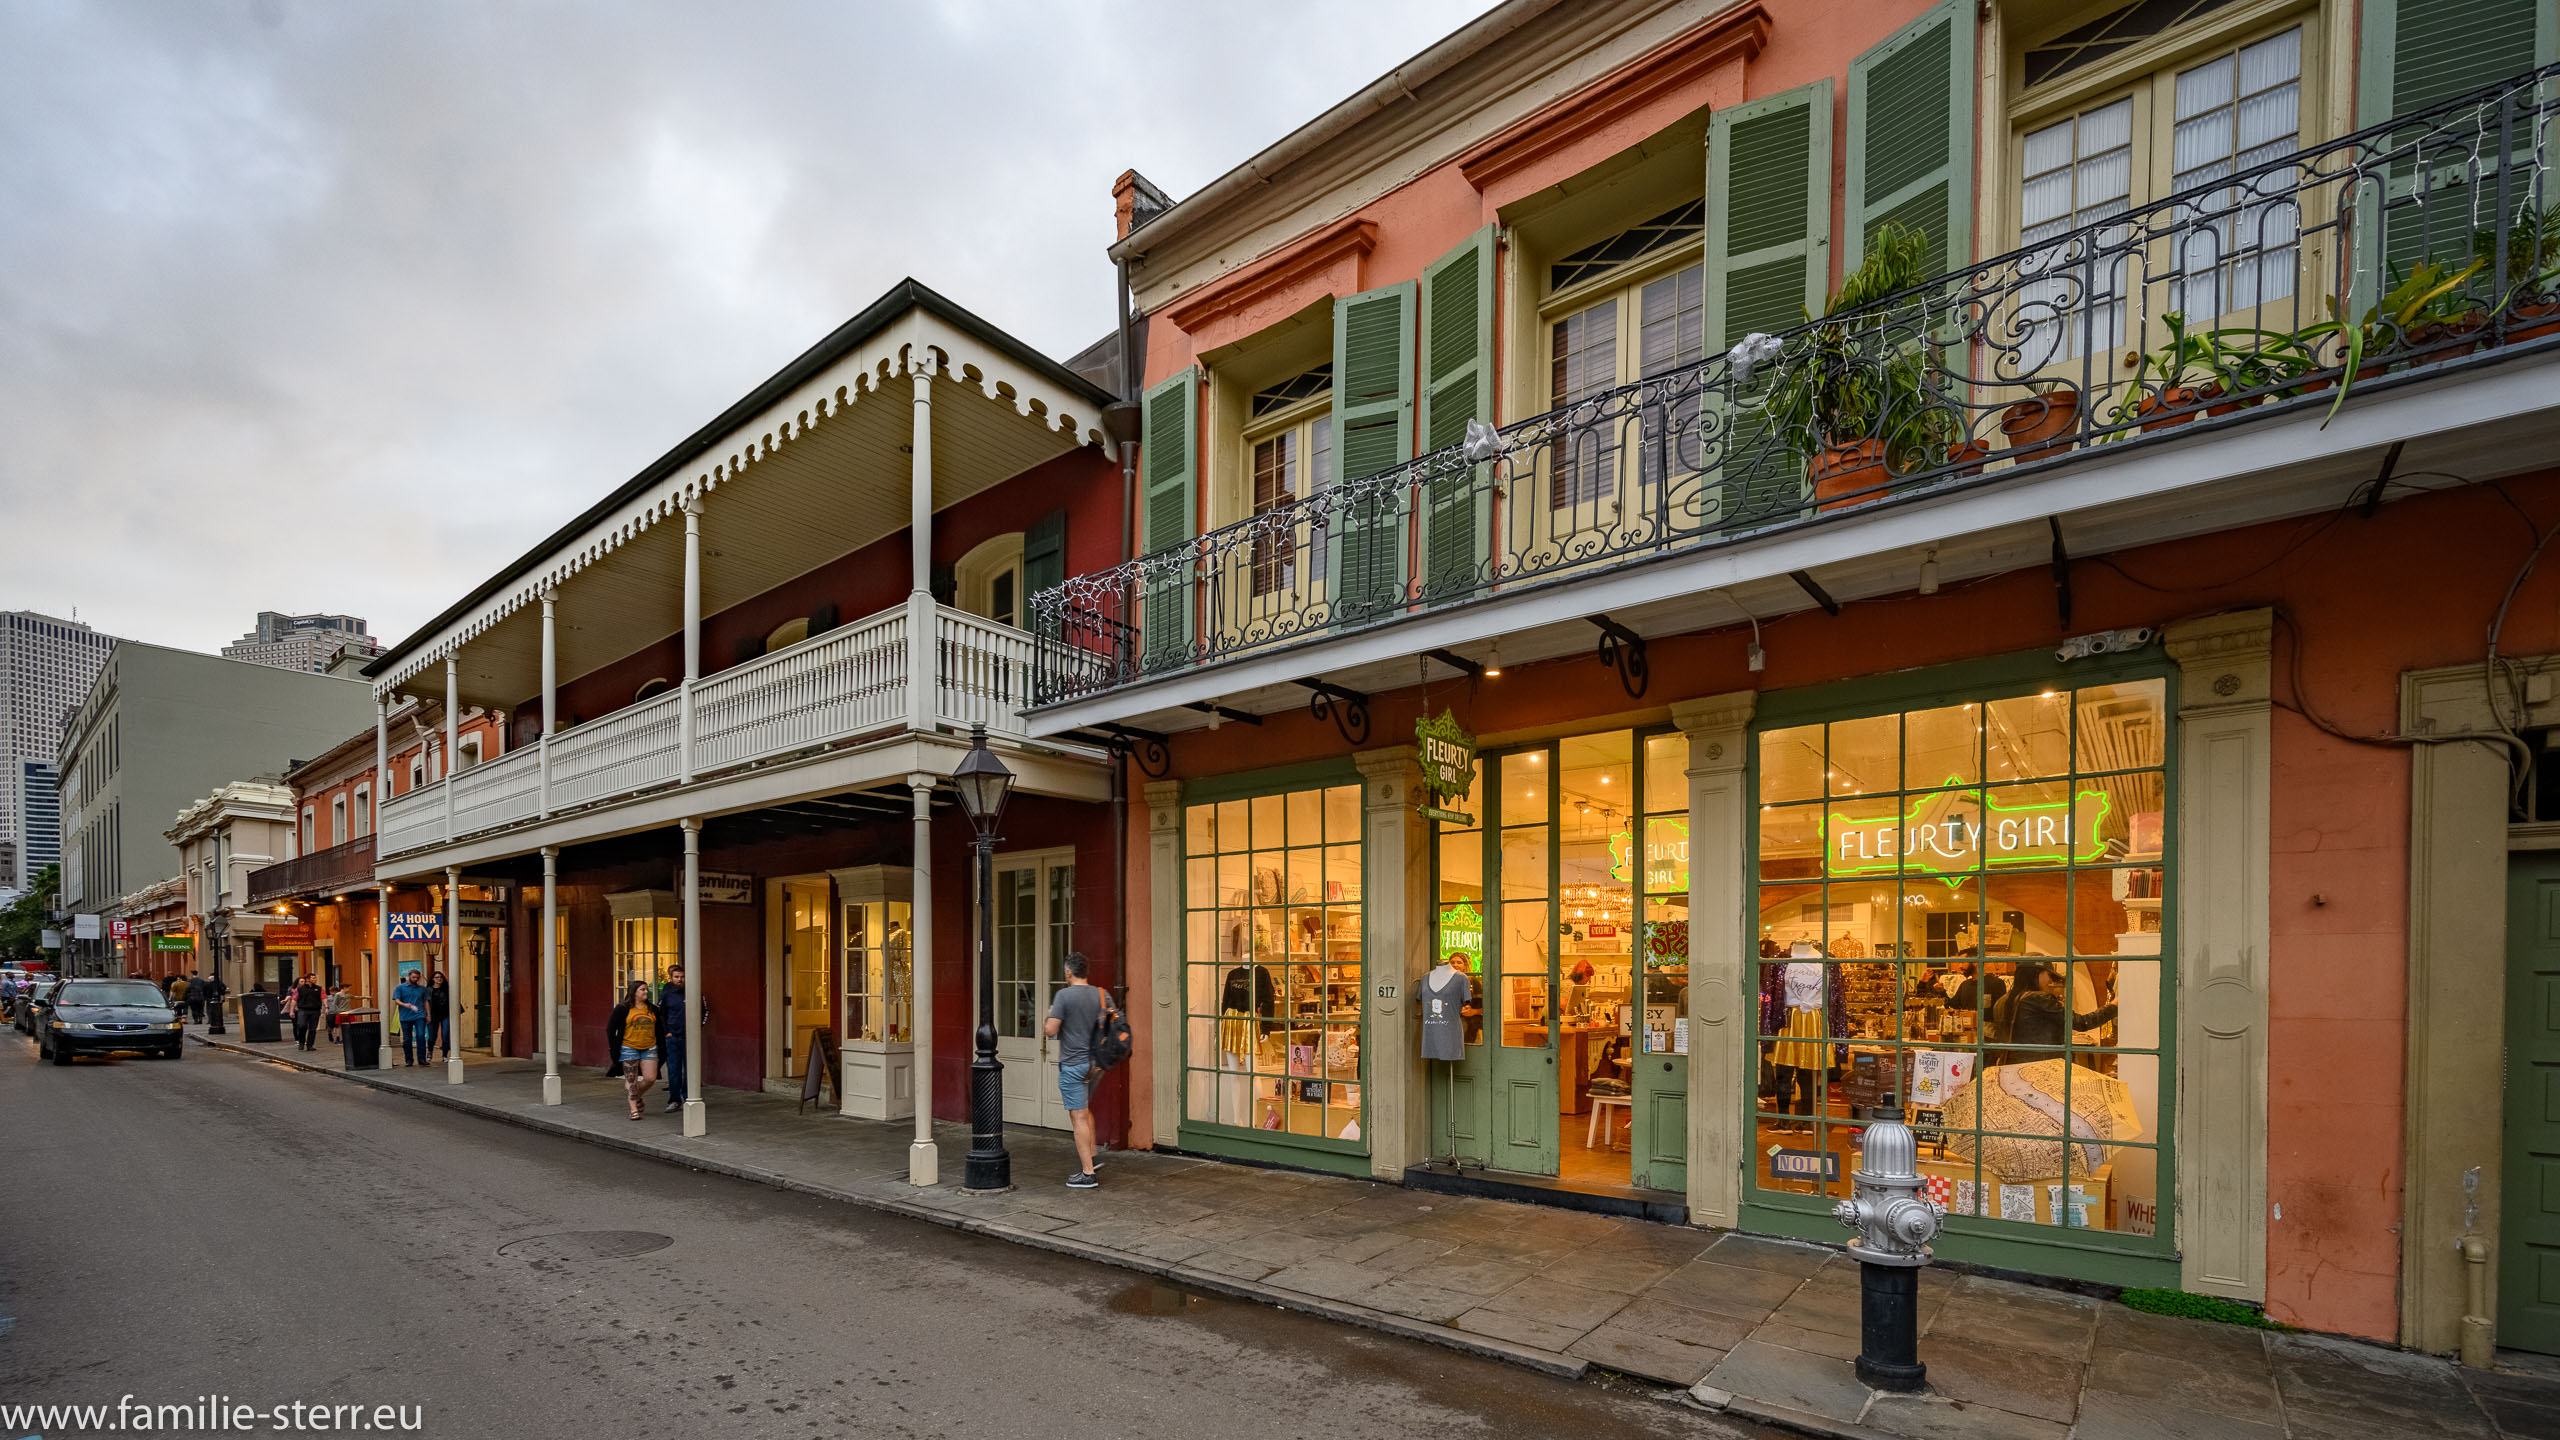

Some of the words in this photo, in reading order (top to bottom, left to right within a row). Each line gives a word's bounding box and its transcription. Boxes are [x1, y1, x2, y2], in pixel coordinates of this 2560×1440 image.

[1426, 737, 1469, 772] FLEURTY
[1440, 764, 1457, 783] GIRL
[1840, 821, 1981, 860] FLEURTY
[1999, 814, 2079, 851] GIRL
[682, 875, 751, 890] emline
[390, 914, 404, 924] 24
[406, 914, 437, 924] HOUR
[458, 908, 496, 918] emline
[116, 922, 125, 931] P
[389, 925, 440, 939] ATM
[1378, 986, 1396, 998] 617
